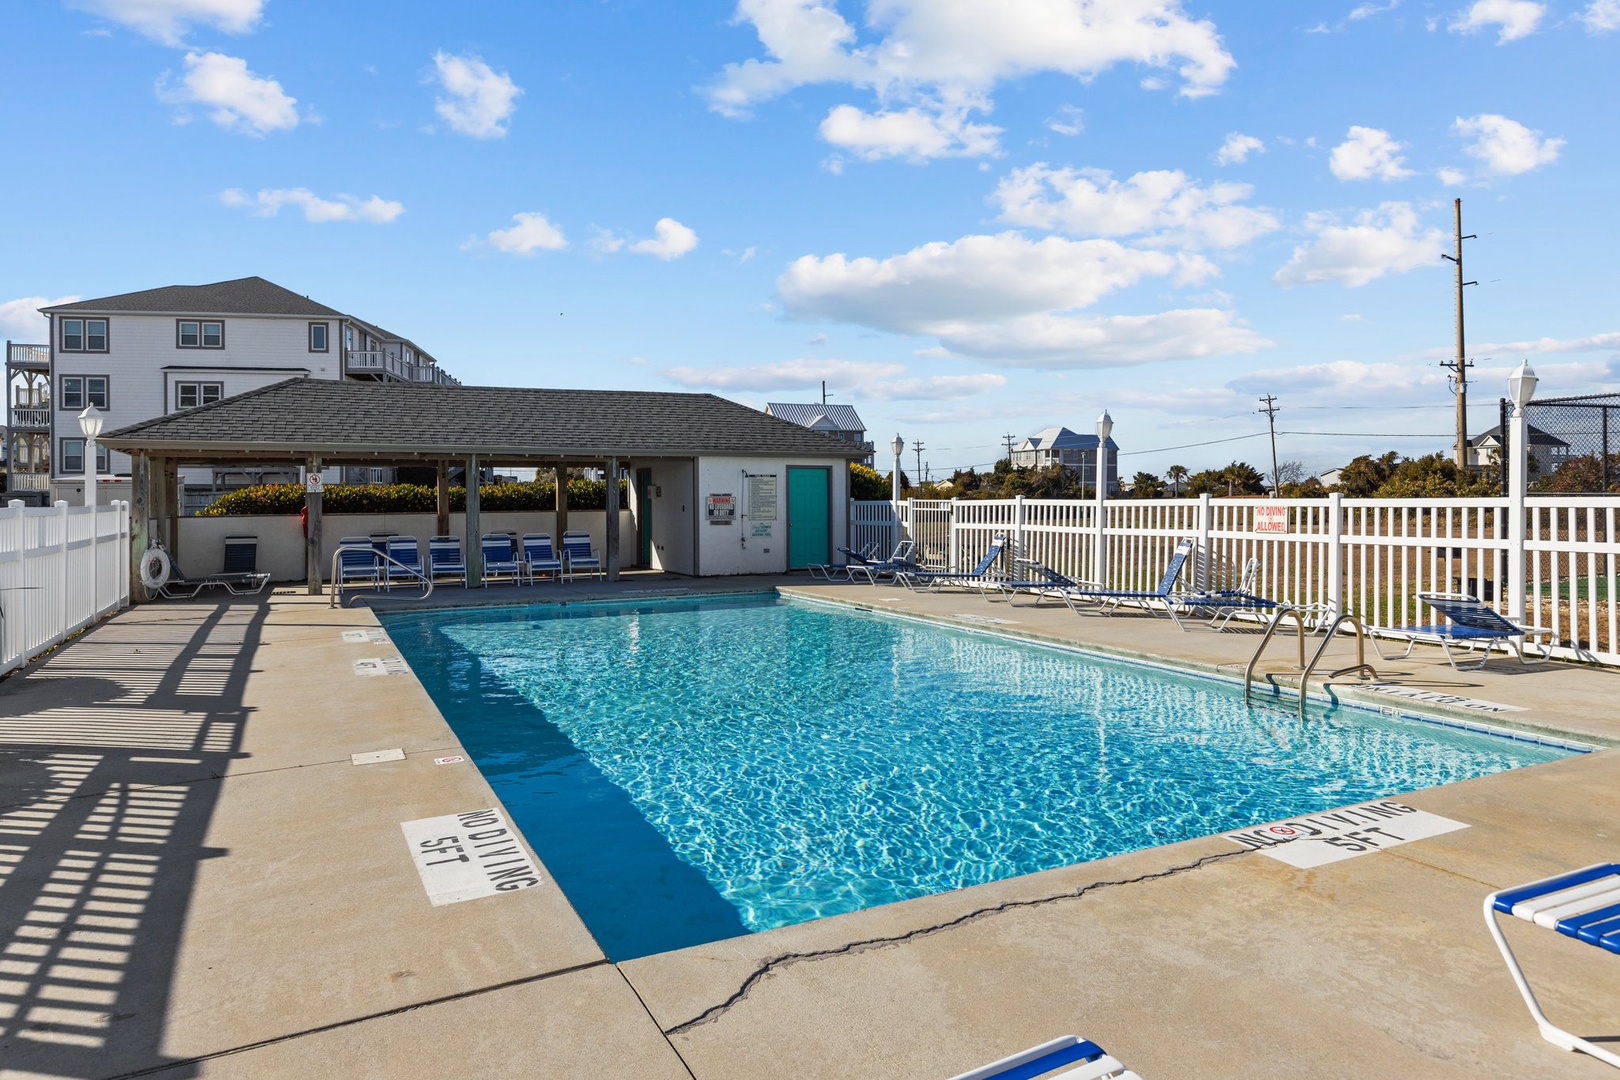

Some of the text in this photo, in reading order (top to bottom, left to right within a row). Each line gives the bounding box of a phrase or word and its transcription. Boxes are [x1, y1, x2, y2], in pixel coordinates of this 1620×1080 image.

[1256, 506, 1286, 516] NO DIVING
[1256, 521, 1286, 531] ALLOWED
[1284, 801, 1418, 836] DIVING
[419, 835, 470, 866] 5FT
[457, 809, 539, 891] NO DIVING
[1323, 826, 1405, 852] 5FT
